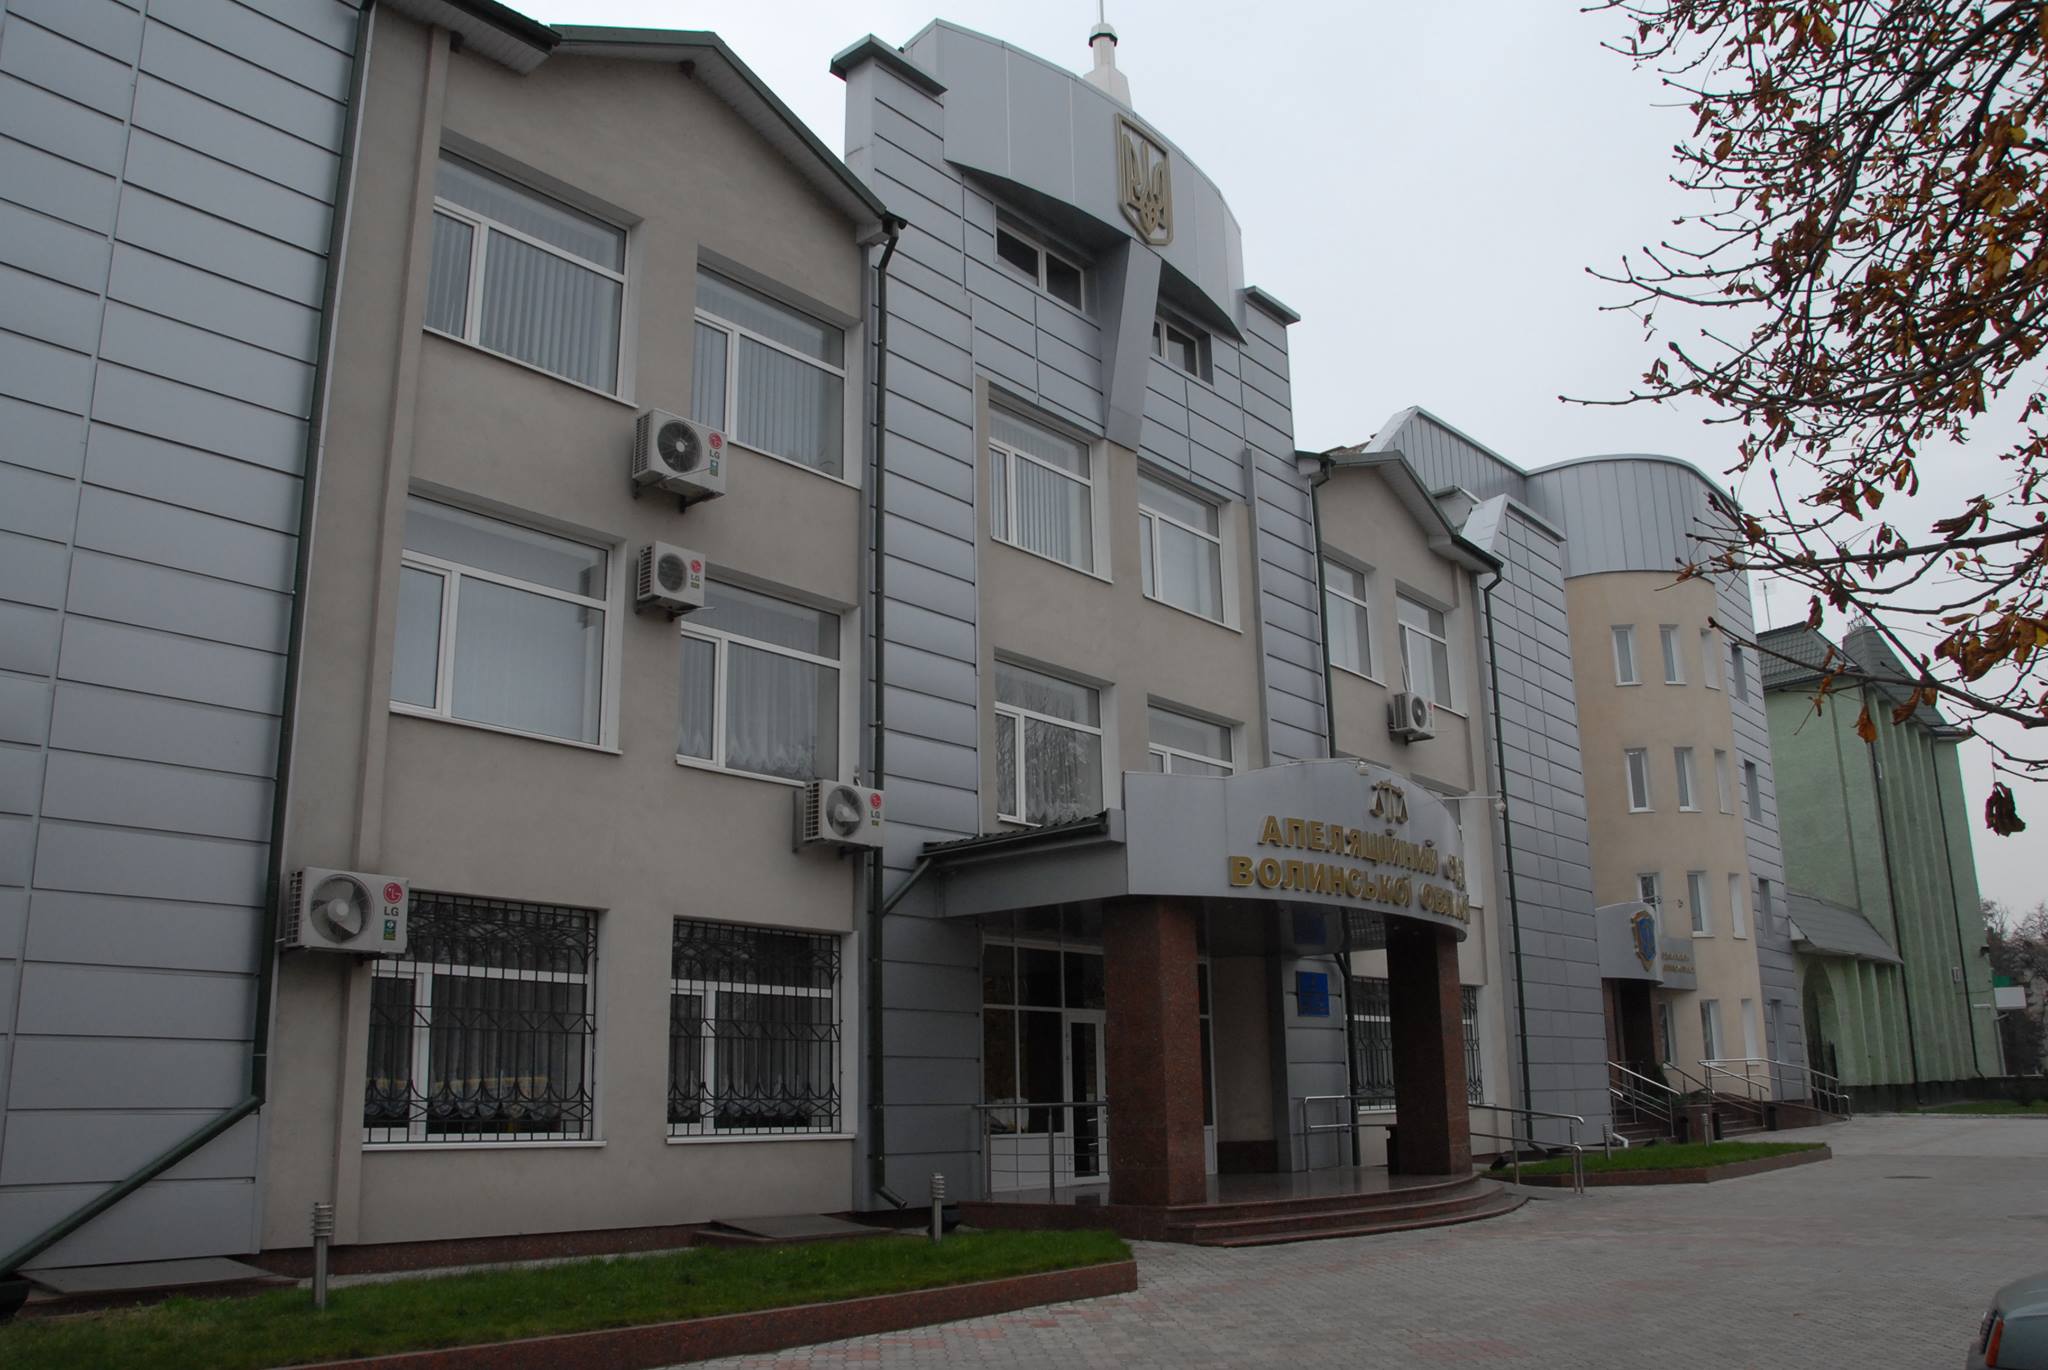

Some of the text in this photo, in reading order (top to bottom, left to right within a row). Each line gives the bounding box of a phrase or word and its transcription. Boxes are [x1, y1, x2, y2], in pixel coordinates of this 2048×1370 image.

[709, 450, 720, 460] LG
[691, 573, 700, 582] LG
[1228, 855, 1413, 908] ВОЛИНСЬКОЇ
[384, 906, 399, 917] LG
